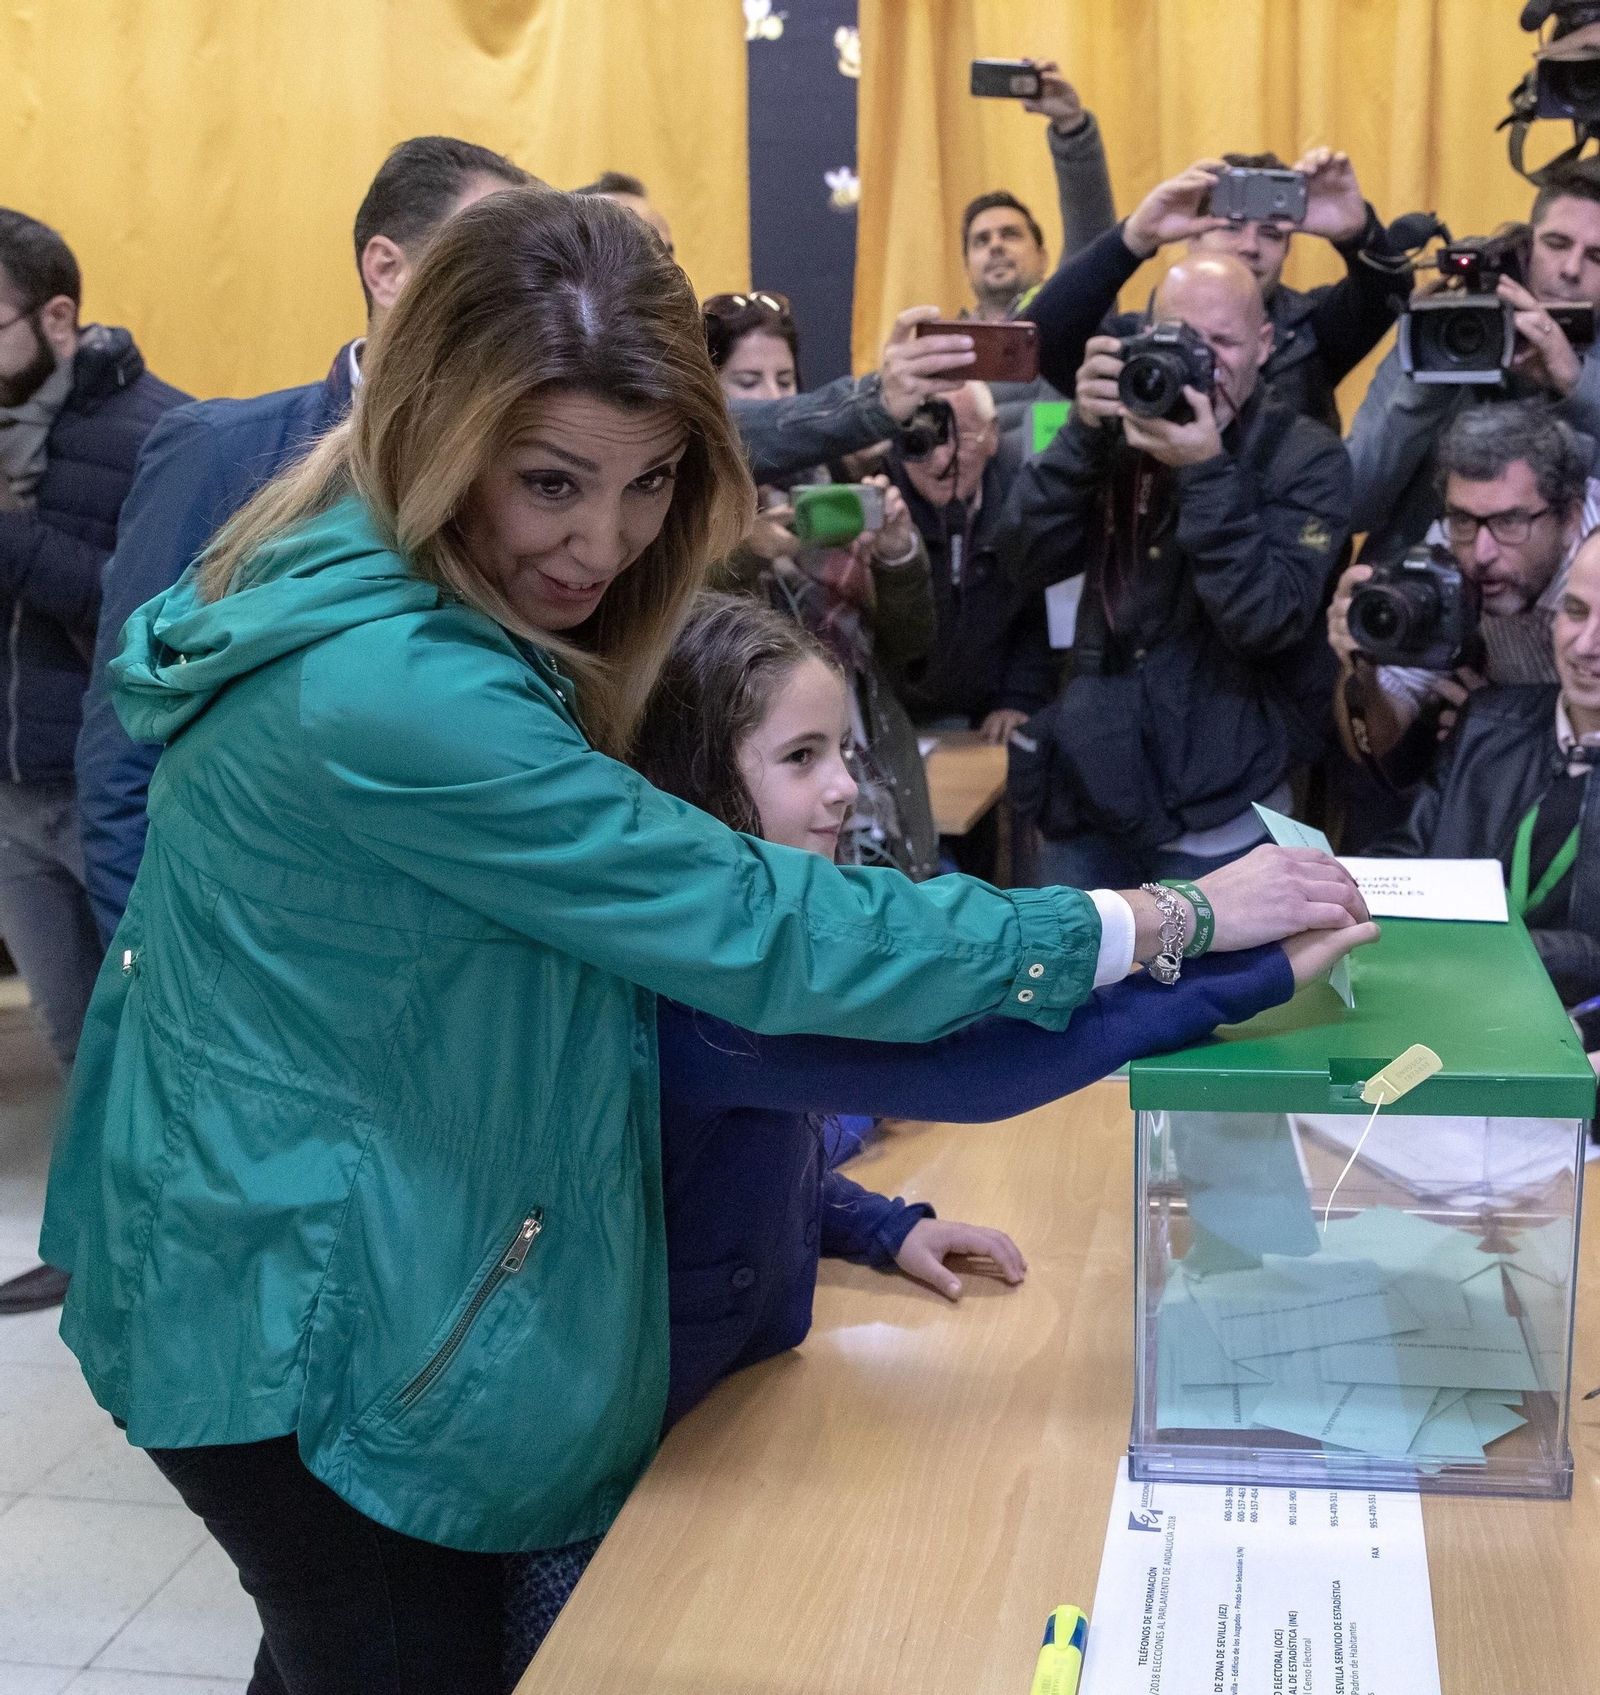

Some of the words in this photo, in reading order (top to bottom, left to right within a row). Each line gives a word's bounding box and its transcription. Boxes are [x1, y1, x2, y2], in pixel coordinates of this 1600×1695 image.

[1224, 1487, 1233, 1521] 600-158-396
[1237, 1488, 1246, 1522] 600-157-463
[1250, 1488, 1259, 1523] 600-157-454
[1289, 1490, 1297, 1526] 901-101-900
[1330, 1492, 1338, 1527] 955-470-511
[1368, 1494, 1378, 1528] 955-470-551
[1168, 1516, 1176, 1530] 2018
[1164, 1532, 1174, 1565] ANDALUCÍA
[1371, 1547, 1380, 1558] FAX
[1163, 1567, 1171, 1575] DE
[1235, 1559, 1243, 1582] Sebastián
[1144, 1567, 1157, 1614] INFORMACIÓN
[1158, 1577, 1170, 1619] PARLAMENTO
[1234, 1594, 1242, 1609] Prado
[1331, 1580, 1342, 1620] ESTADÍSTICA
[1143, 1615, 1152, 1624] DE
[1218, 1604, 1229, 1619] (JEZ)
[1233, 1613, 1242, 1637] Juzgados
[1288, 1611, 1298, 1627] (INE)
[1217, 1621, 1226, 1647] SEVILLA
[1274, 1629, 1284, 1648] (OCE)
[1333, 1622, 1342, 1630] DE
[1138, 1626, 1151, 1666] TELÉFONOS
[1154, 1631, 1164, 1672] ELECCIONES
[1216, 1649, 1225, 1658] DE
[1287, 1629, 1297, 1672] ESTADÍSTICA
[1303, 1638, 1312, 1667] Electoral
[1334, 1633, 1343, 1664] SERVICIO
[1348, 1622, 1357, 1658] Habitantes
[1215, 1661, 1225, 1681] ZONA
[1274, 1650, 1283, 1689] ELECTORAL
[1350, 1660, 1358, 1668] de
[1215, 1683, 1223, 1692] DE
[1289, 1674, 1297, 1683] DE
[1304, 1669, 1312, 1691] Censo
[1335, 1666, 1344, 1694] SEVILLA
